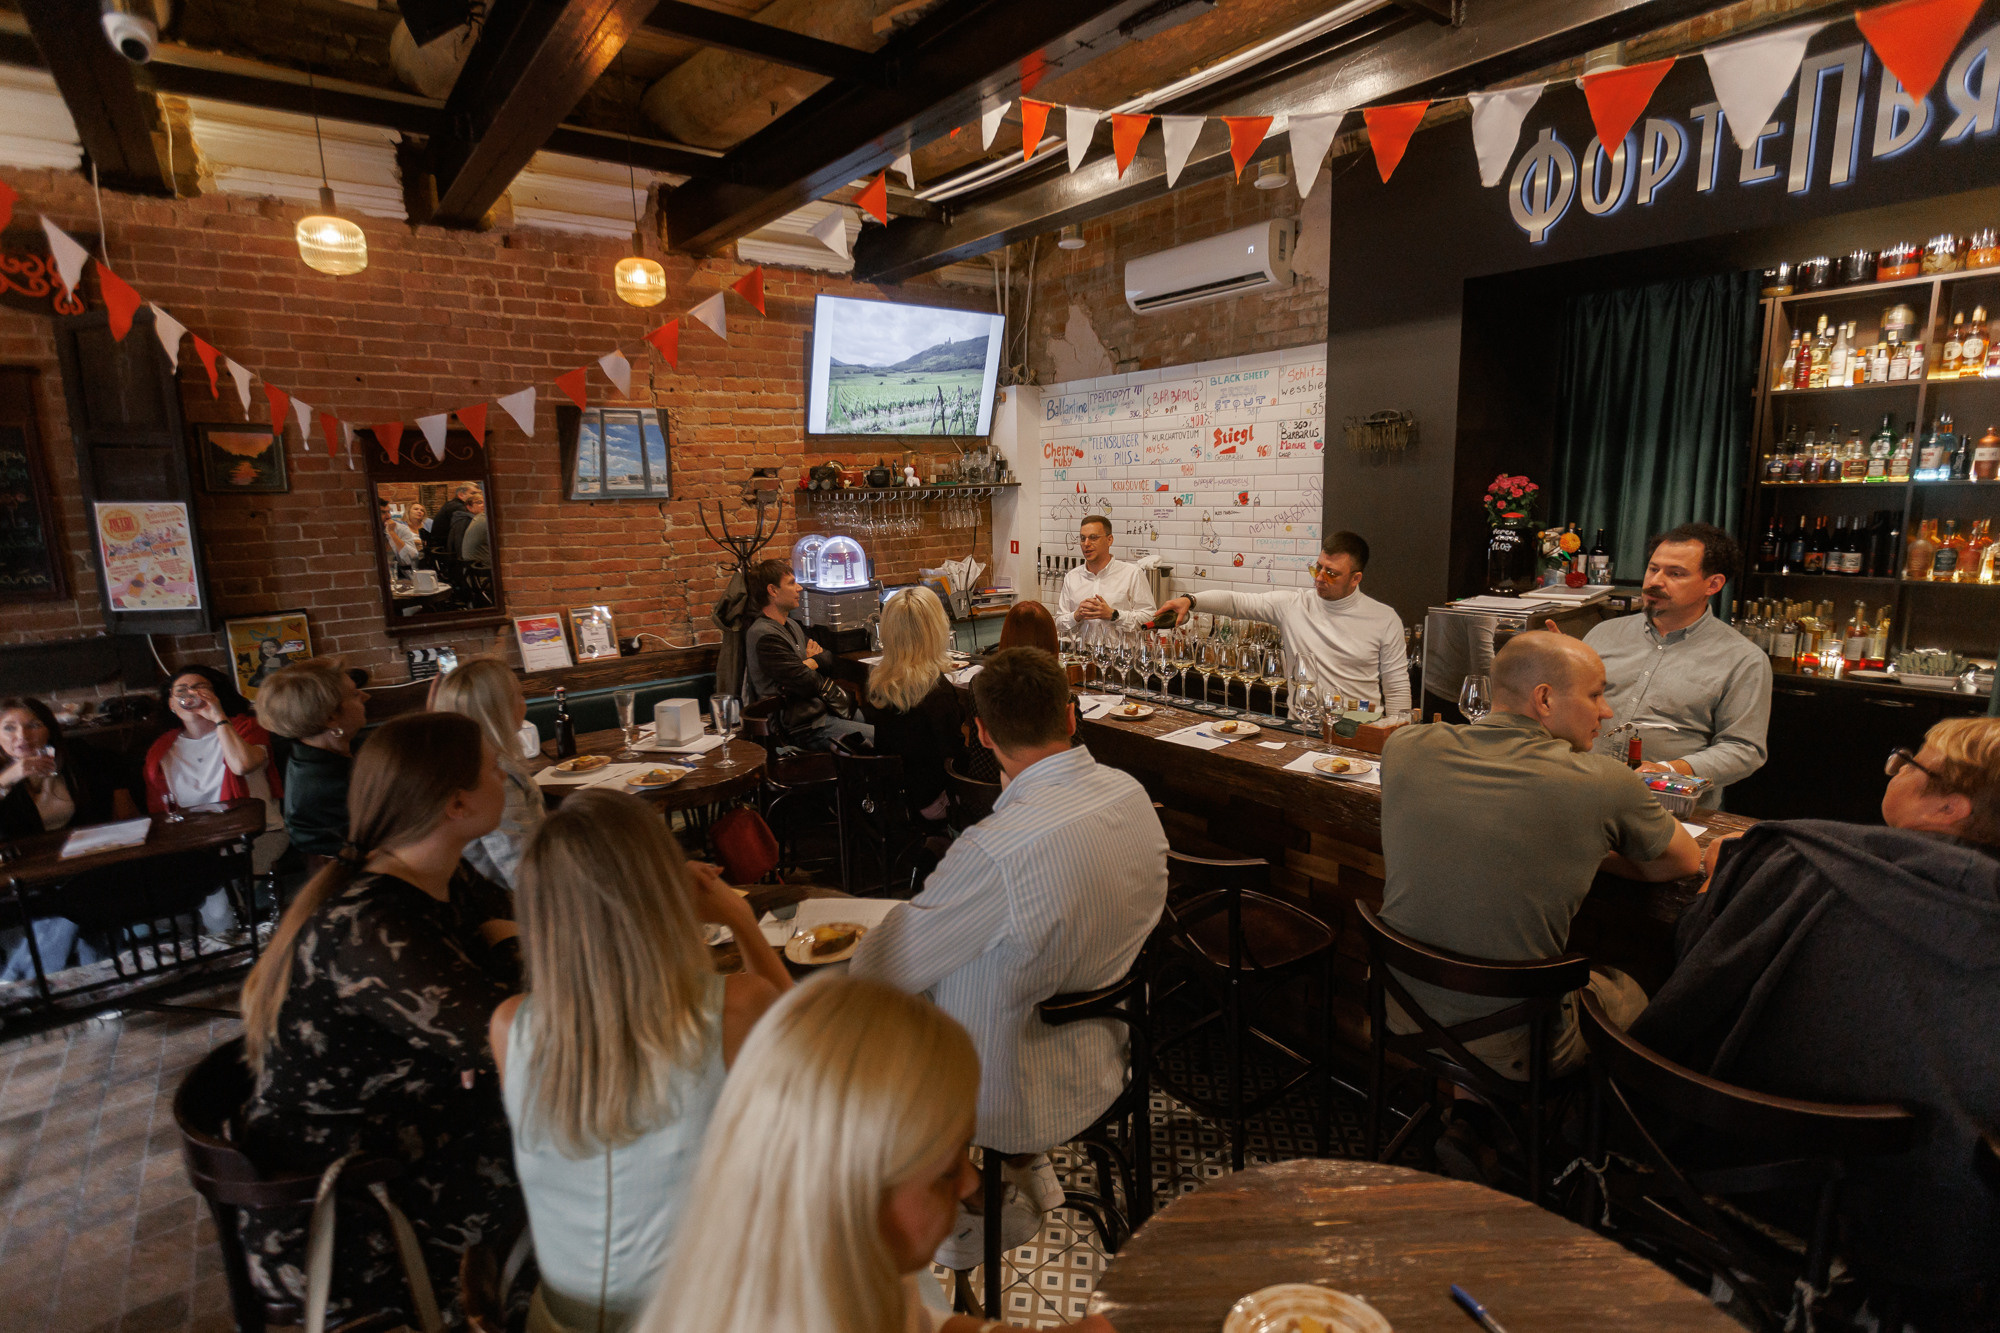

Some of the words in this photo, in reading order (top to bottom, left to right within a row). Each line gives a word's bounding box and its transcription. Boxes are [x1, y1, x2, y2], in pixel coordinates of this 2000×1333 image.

[1210, 373, 1241, 386] BLACK
[1243, 369, 1270, 381] SHEEP
[1282, 380, 1326, 396] wessbie
[1047, 397, 1087, 420] Ballantine
[1213, 424, 1254, 448] Stiegl
[1044, 441, 1076, 459] Cherry
[1053, 454, 1073, 468] ruby
